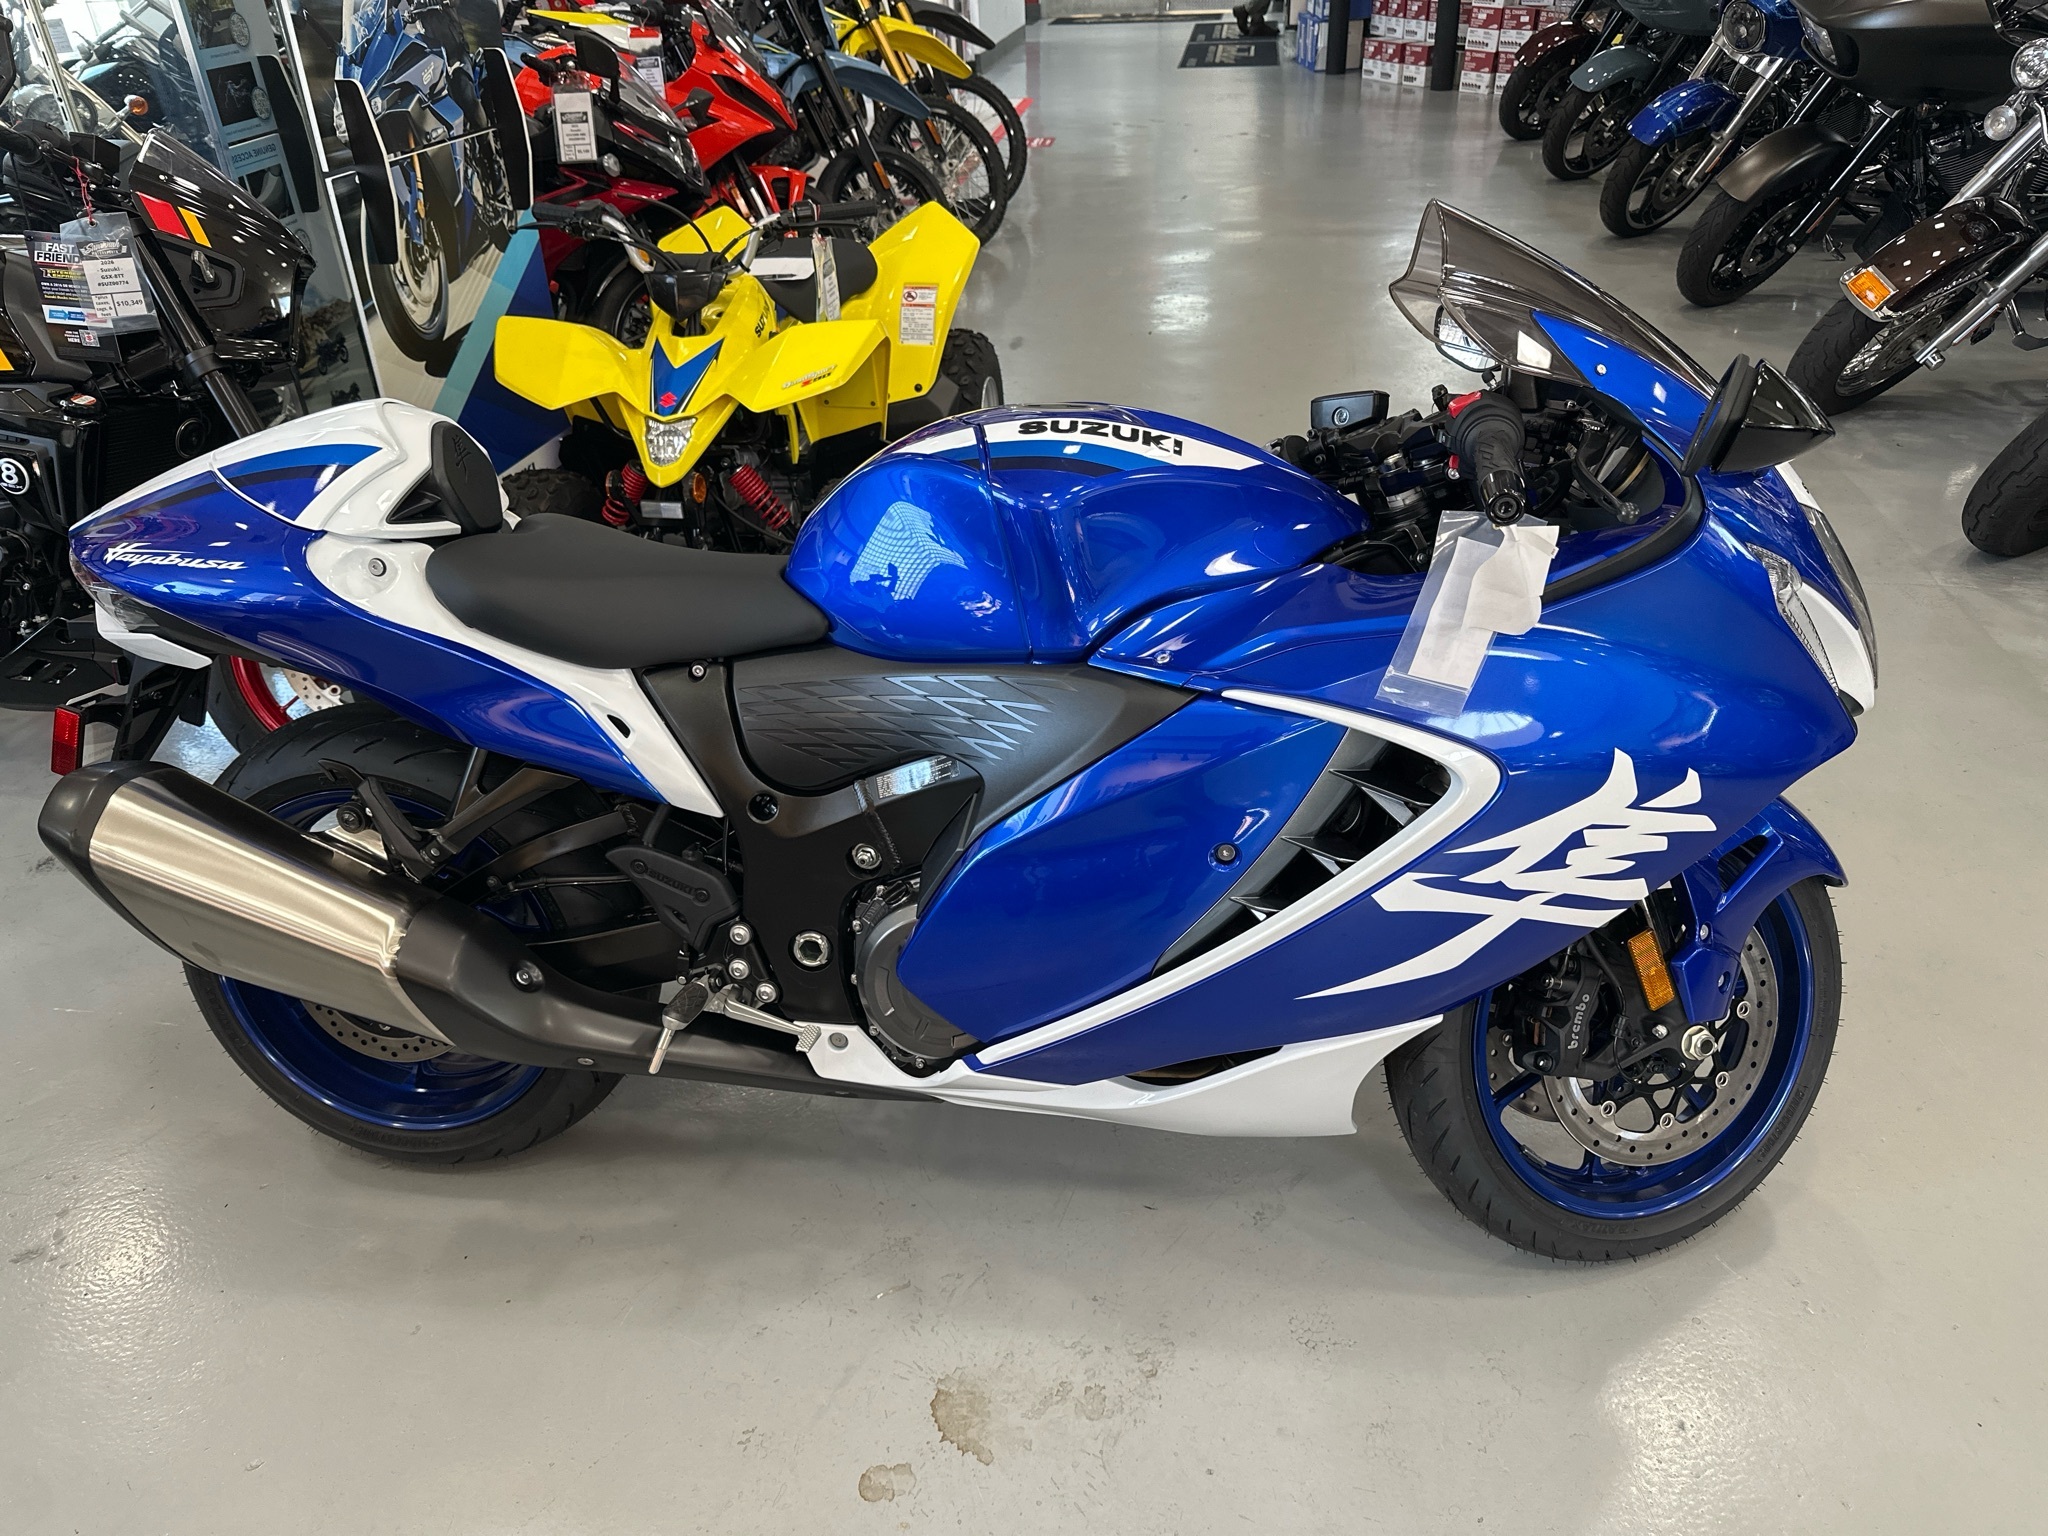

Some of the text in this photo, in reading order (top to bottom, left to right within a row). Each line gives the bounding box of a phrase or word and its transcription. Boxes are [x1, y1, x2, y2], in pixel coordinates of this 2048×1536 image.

[613, 12, 635, 21] SUZUKI
[532, 40, 556, 50] SUZUKI
[45, 242, 75, 254] FAST
[1018, 420, 1184, 456] SUZUKI
[1, 462, 19, 485] 8
[103, 543, 250, 571] Hayabusa
[648, 869, 694, 895] SUZUKI
[1567, 993, 1590, 1050] brembo
